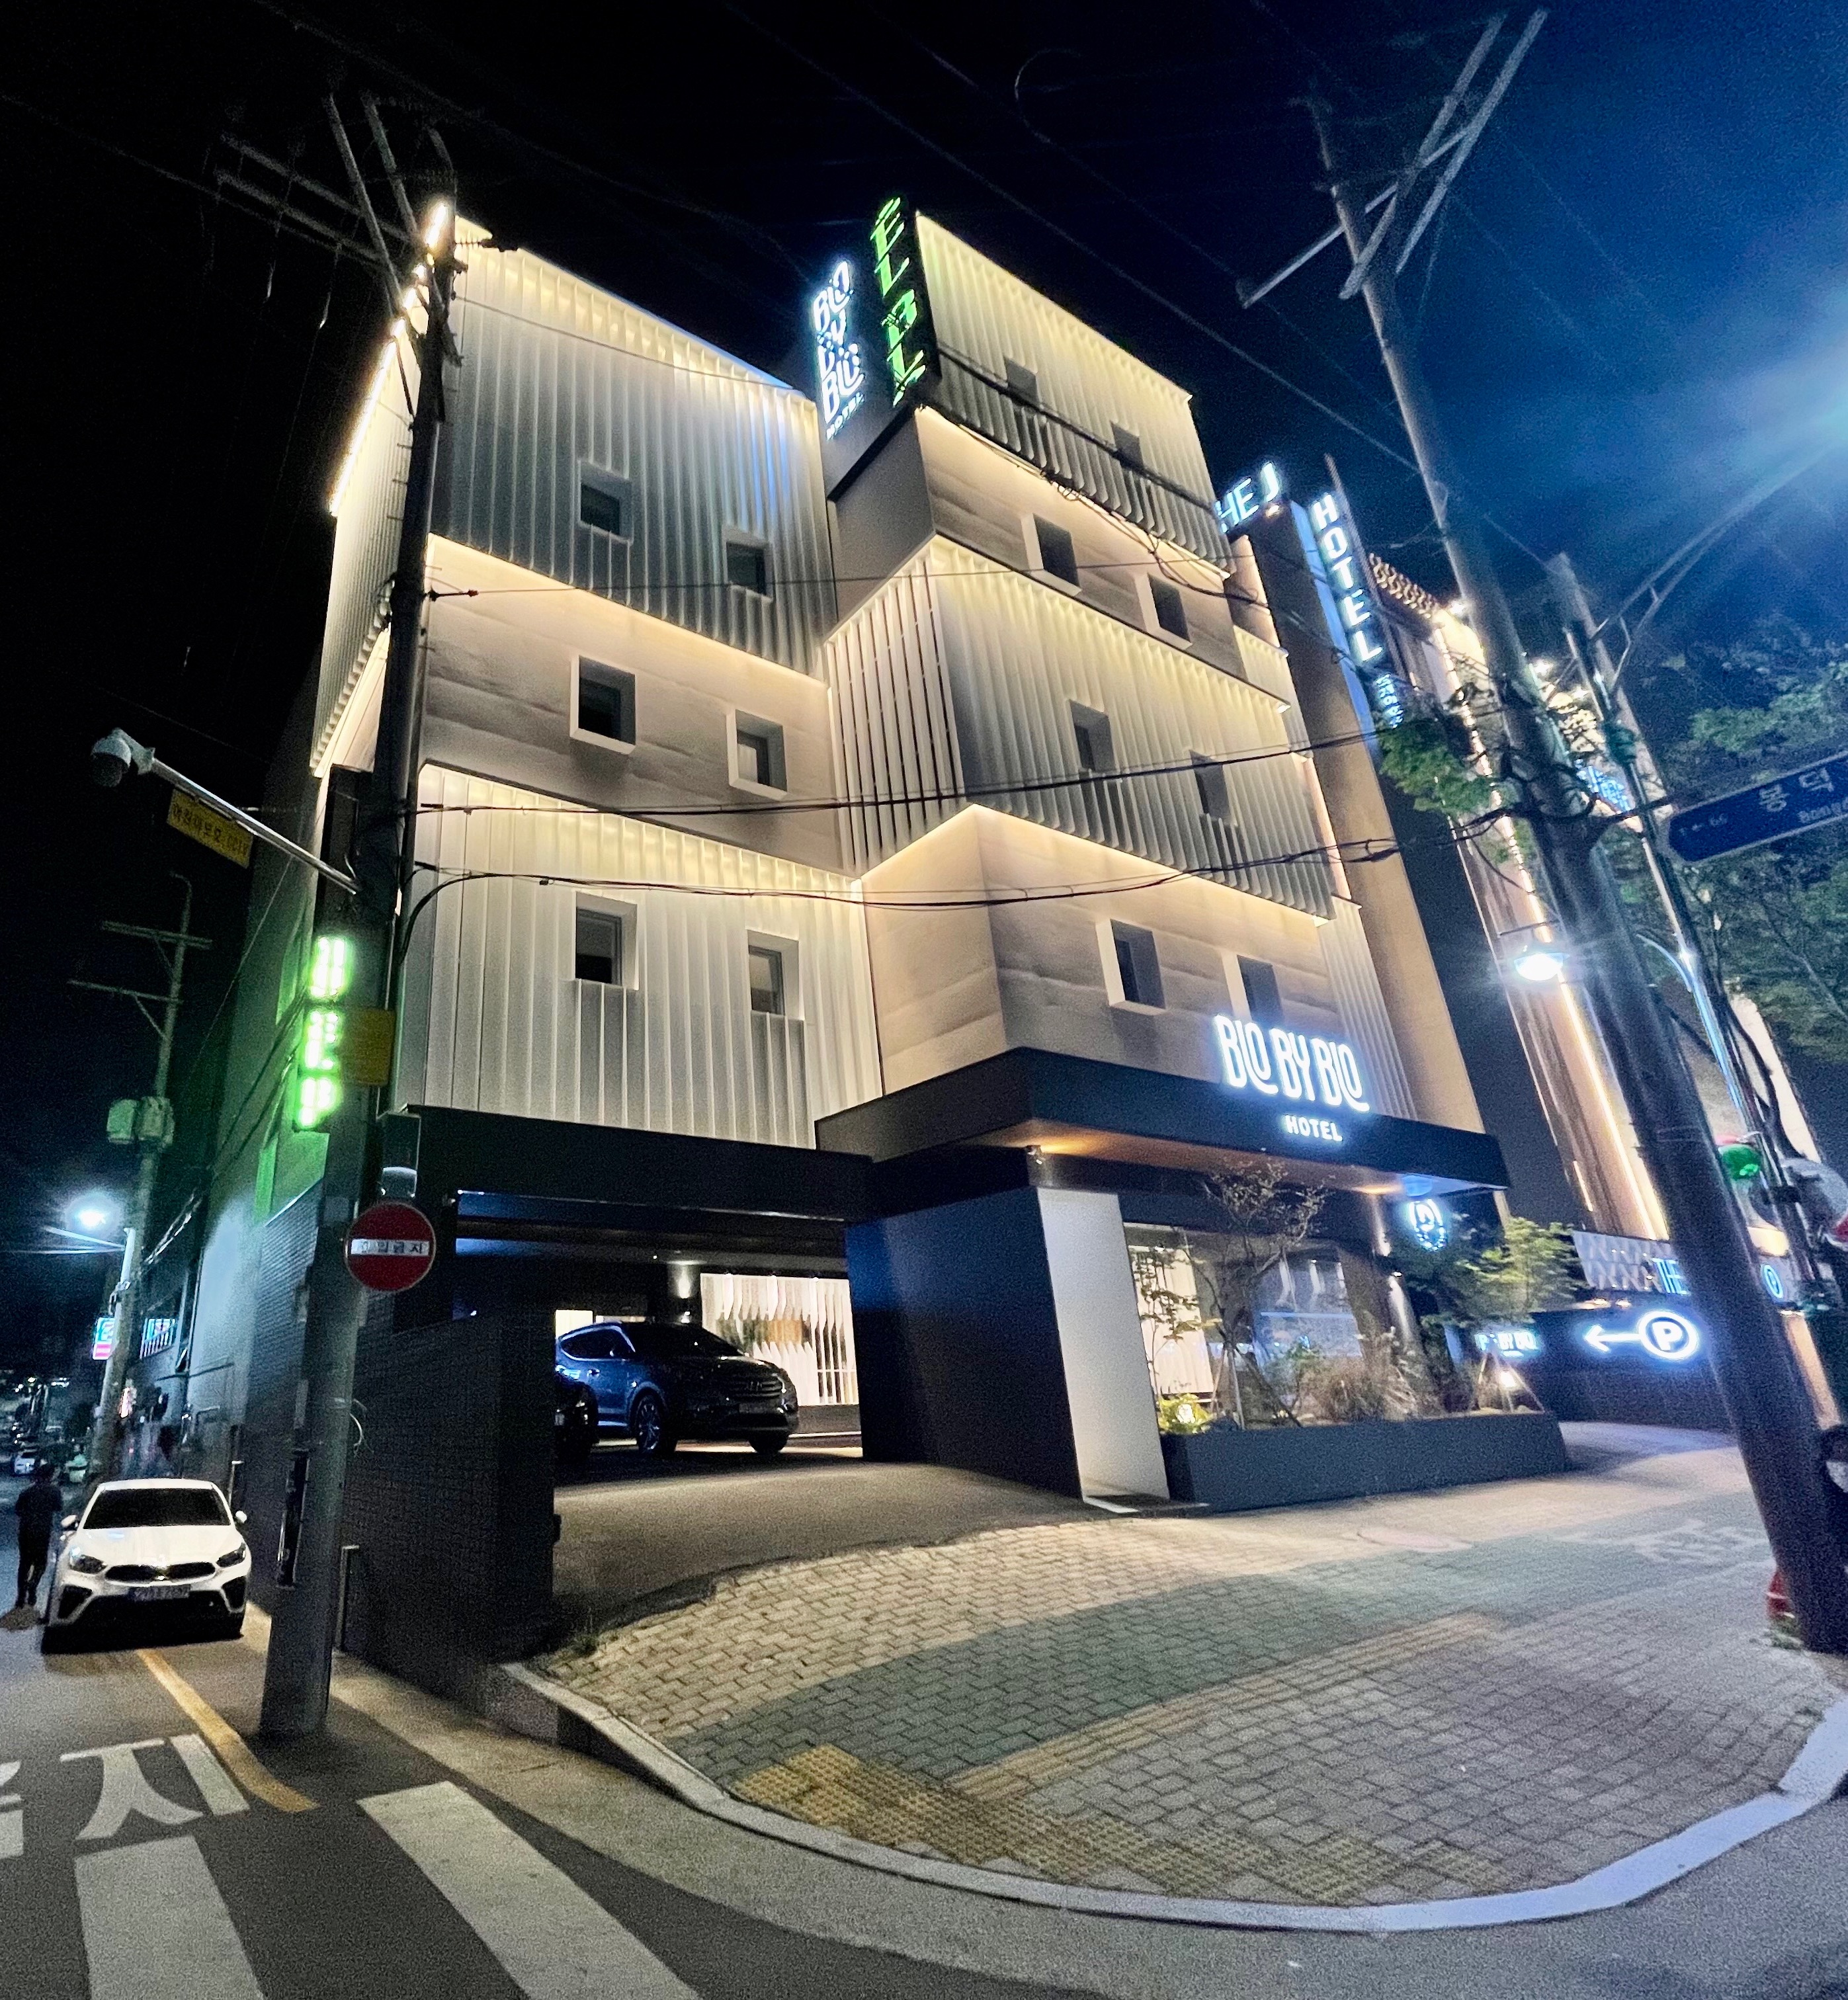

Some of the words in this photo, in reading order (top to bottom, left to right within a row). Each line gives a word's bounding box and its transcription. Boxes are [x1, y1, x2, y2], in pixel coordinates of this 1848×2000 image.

[1312, 492, 1383, 662] HOTEL
[1213, 1014, 1279, 1095] BIO
[1269, 1028, 1316, 1102] BY
[1310, 1037, 1370, 1112] BIO
[1284, 1114, 1343, 1142] HOTEL
